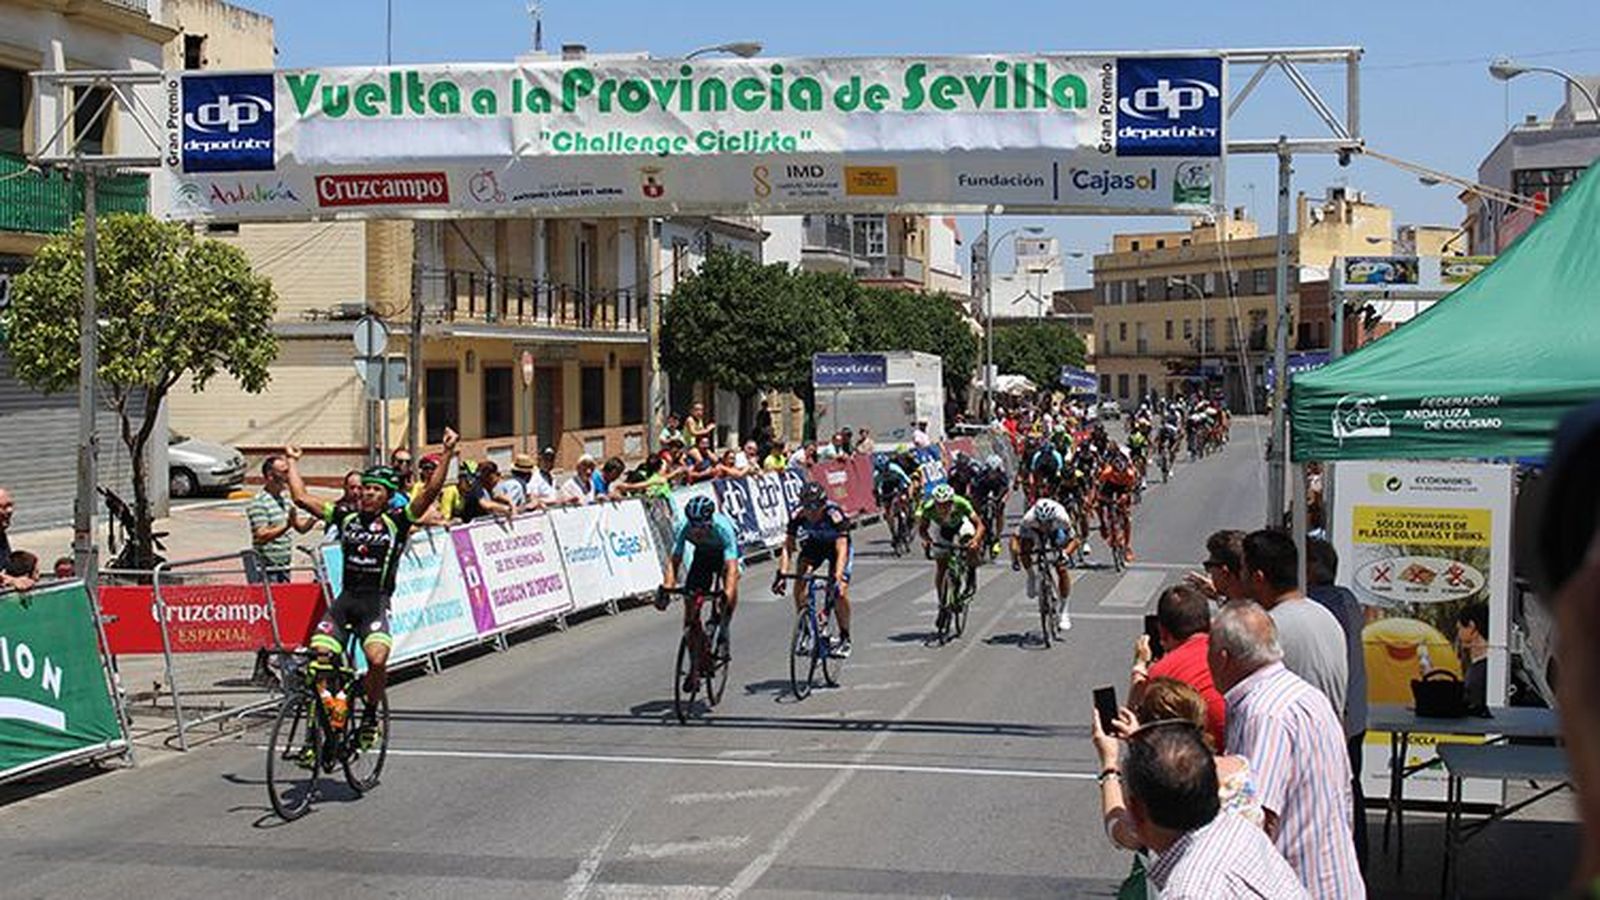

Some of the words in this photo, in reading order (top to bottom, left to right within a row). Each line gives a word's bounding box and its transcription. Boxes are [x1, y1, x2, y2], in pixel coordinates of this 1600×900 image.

[285, 72, 461, 118] Vuelta
[471, 88, 497, 115] a
[513, 79, 552, 114] la
[562, 64, 823, 113] Provincia
[833, 75, 890, 112] de
[902, 61, 1088, 112] Sevilla
[1098, 62, 1113, 115] Premio
[1134, 79, 1204, 119] dp
[166, 80, 180, 130] Premio
[198, 95, 259, 133] dp
[166, 132, 180, 168] Gran
[539, 130, 689, 157] "Challenge
[696, 130, 812, 152] Ciclista"
[1098, 118, 1113, 155] Gran
[786, 163, 825, 179] IMD
[957, 172, 1045, 188] Fundación
[1072, 166, 1158, 197] Cajasol
[321, 177, 444, 201] Cruzcampo
[1402, 407, 1472, 420] ANDALUZA
[1420, 394, 1501, 408] FEDERACIÓN
[1424, 419, 1441, 431] DE
[1443, 417, 1503, 431] CICLISMO
[1406, 520, 1452, 531] ENVASES
[1411, 530, 1441, 540] LATAS
[1442, 531, 1451, 540] Y
[178, 628, 250, 642] ESPECIAL
